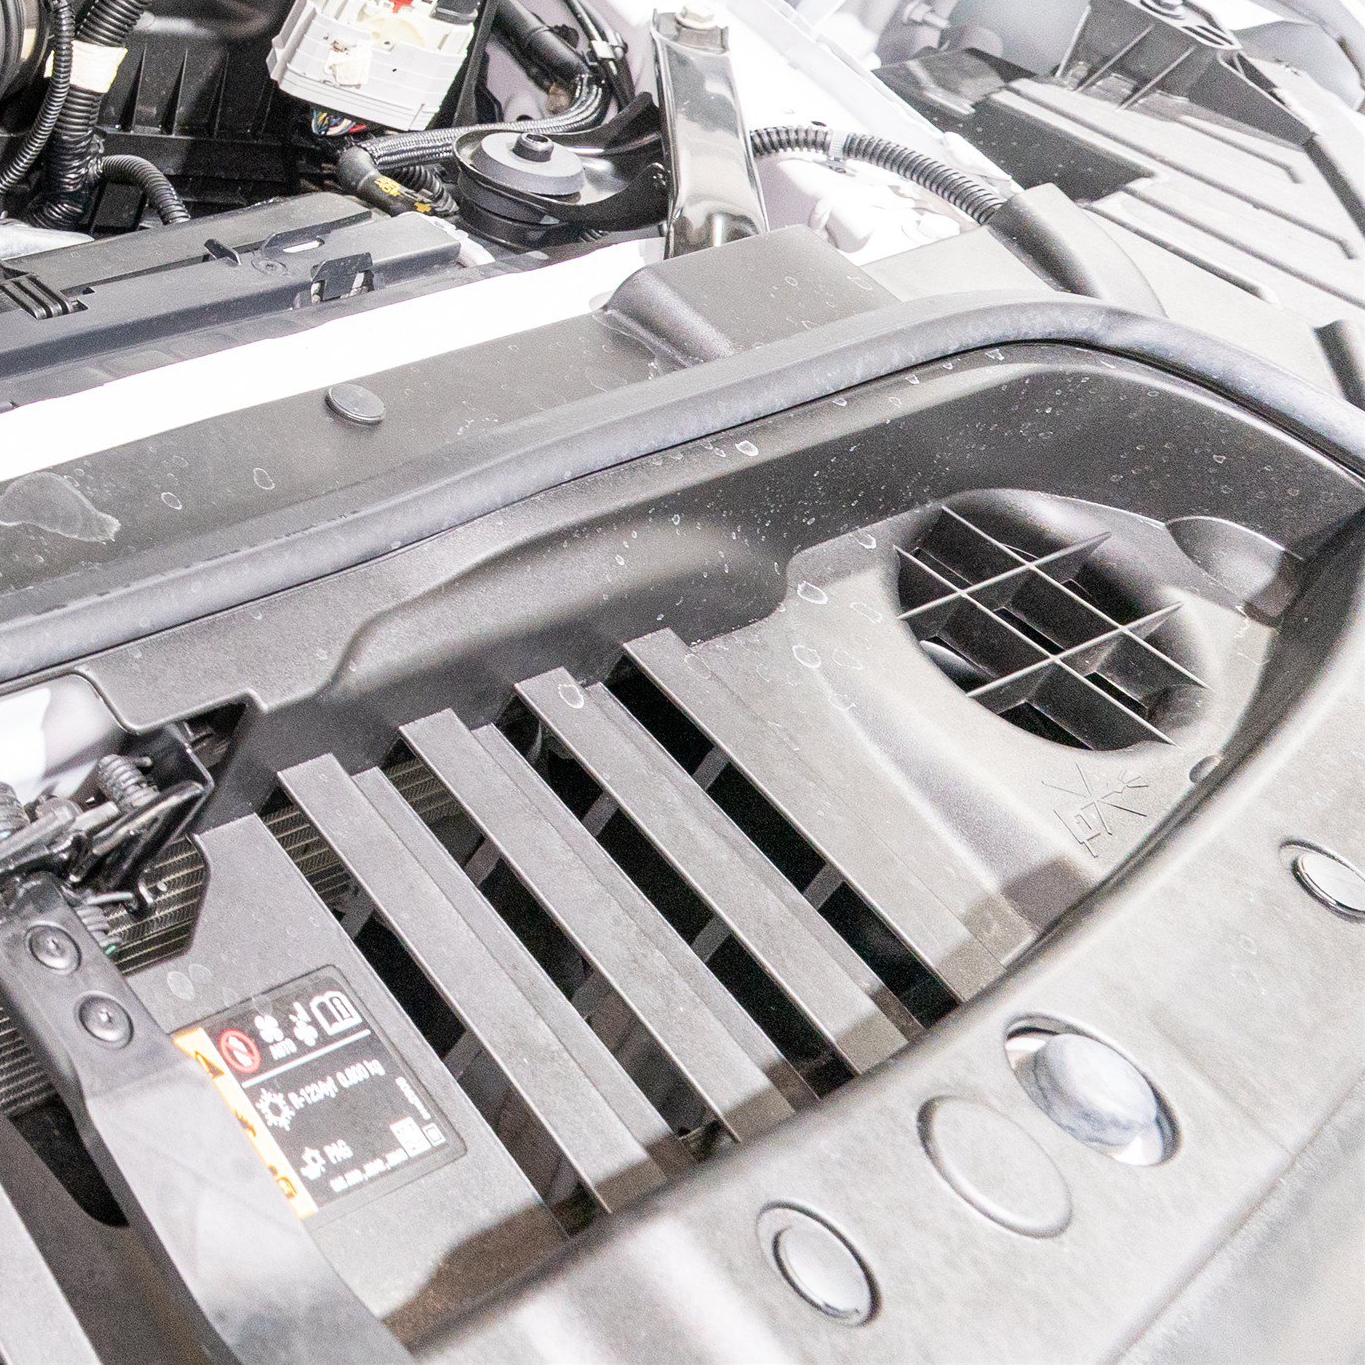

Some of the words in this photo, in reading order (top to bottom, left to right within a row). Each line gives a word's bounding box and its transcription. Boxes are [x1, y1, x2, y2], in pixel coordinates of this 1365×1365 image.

[269, 1037, 297, 1060] AUTO
[363, 1059, 386, 1076] kg
[323, 1139, 354, 1164] PAG
